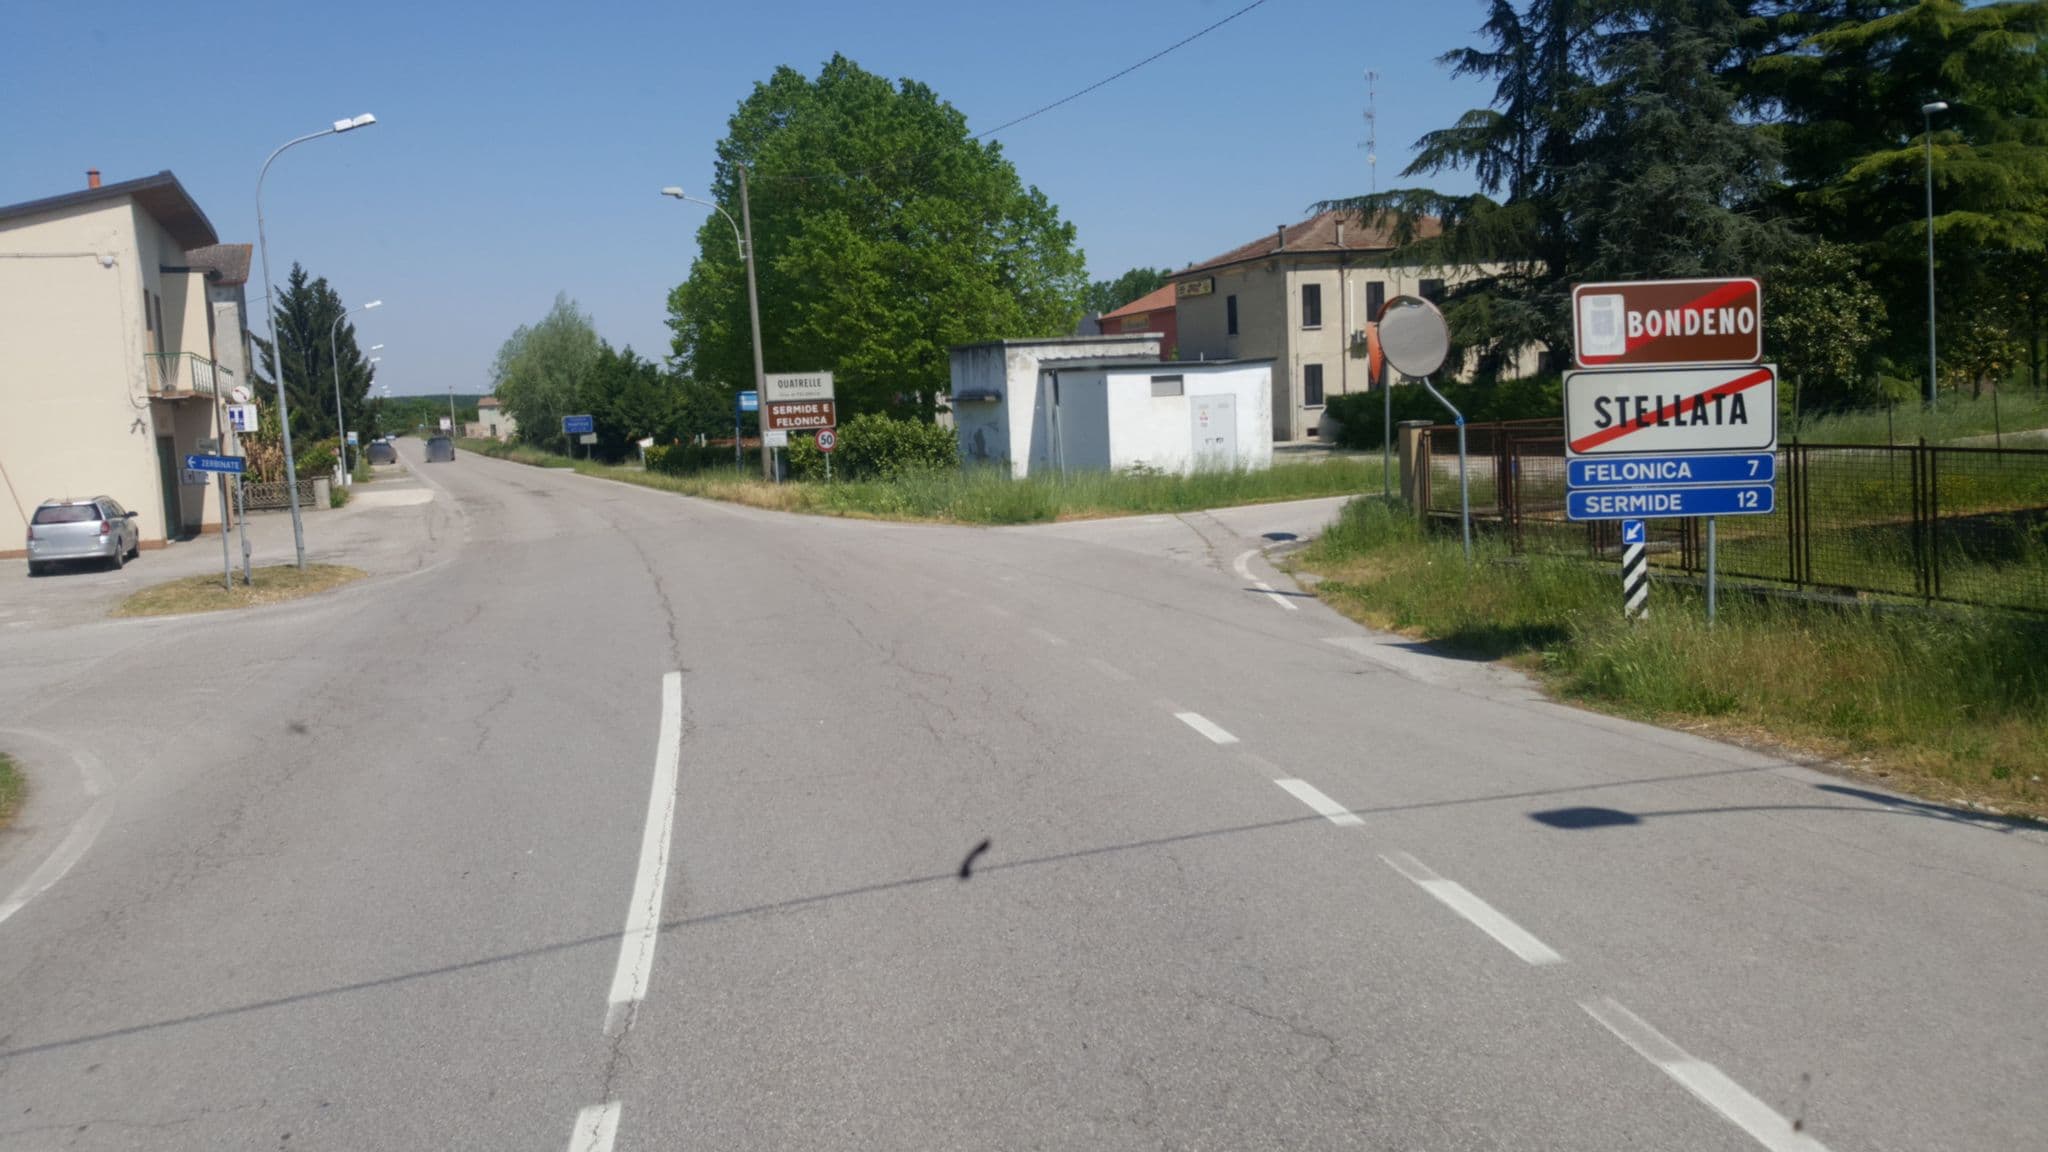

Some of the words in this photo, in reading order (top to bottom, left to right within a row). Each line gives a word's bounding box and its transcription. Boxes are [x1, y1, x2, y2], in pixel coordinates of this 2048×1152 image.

[1628, 306, 1754, 338] BONDENO
[773, 405, 818, 415] SERMIDE
[823, 403, 830, 412] E
[1594, 393, 1748, 429] STELLATA
[776, 416, 827, 426] FELONICA
[820, 435, 833, 445] 50
[1584, 462, 1692, 481] FELONICA
[1747, 460, 1759, 476] 7
[1585, 494, 1682, 512] SERMIDE
[1737, 491, 1758, 508] 12
